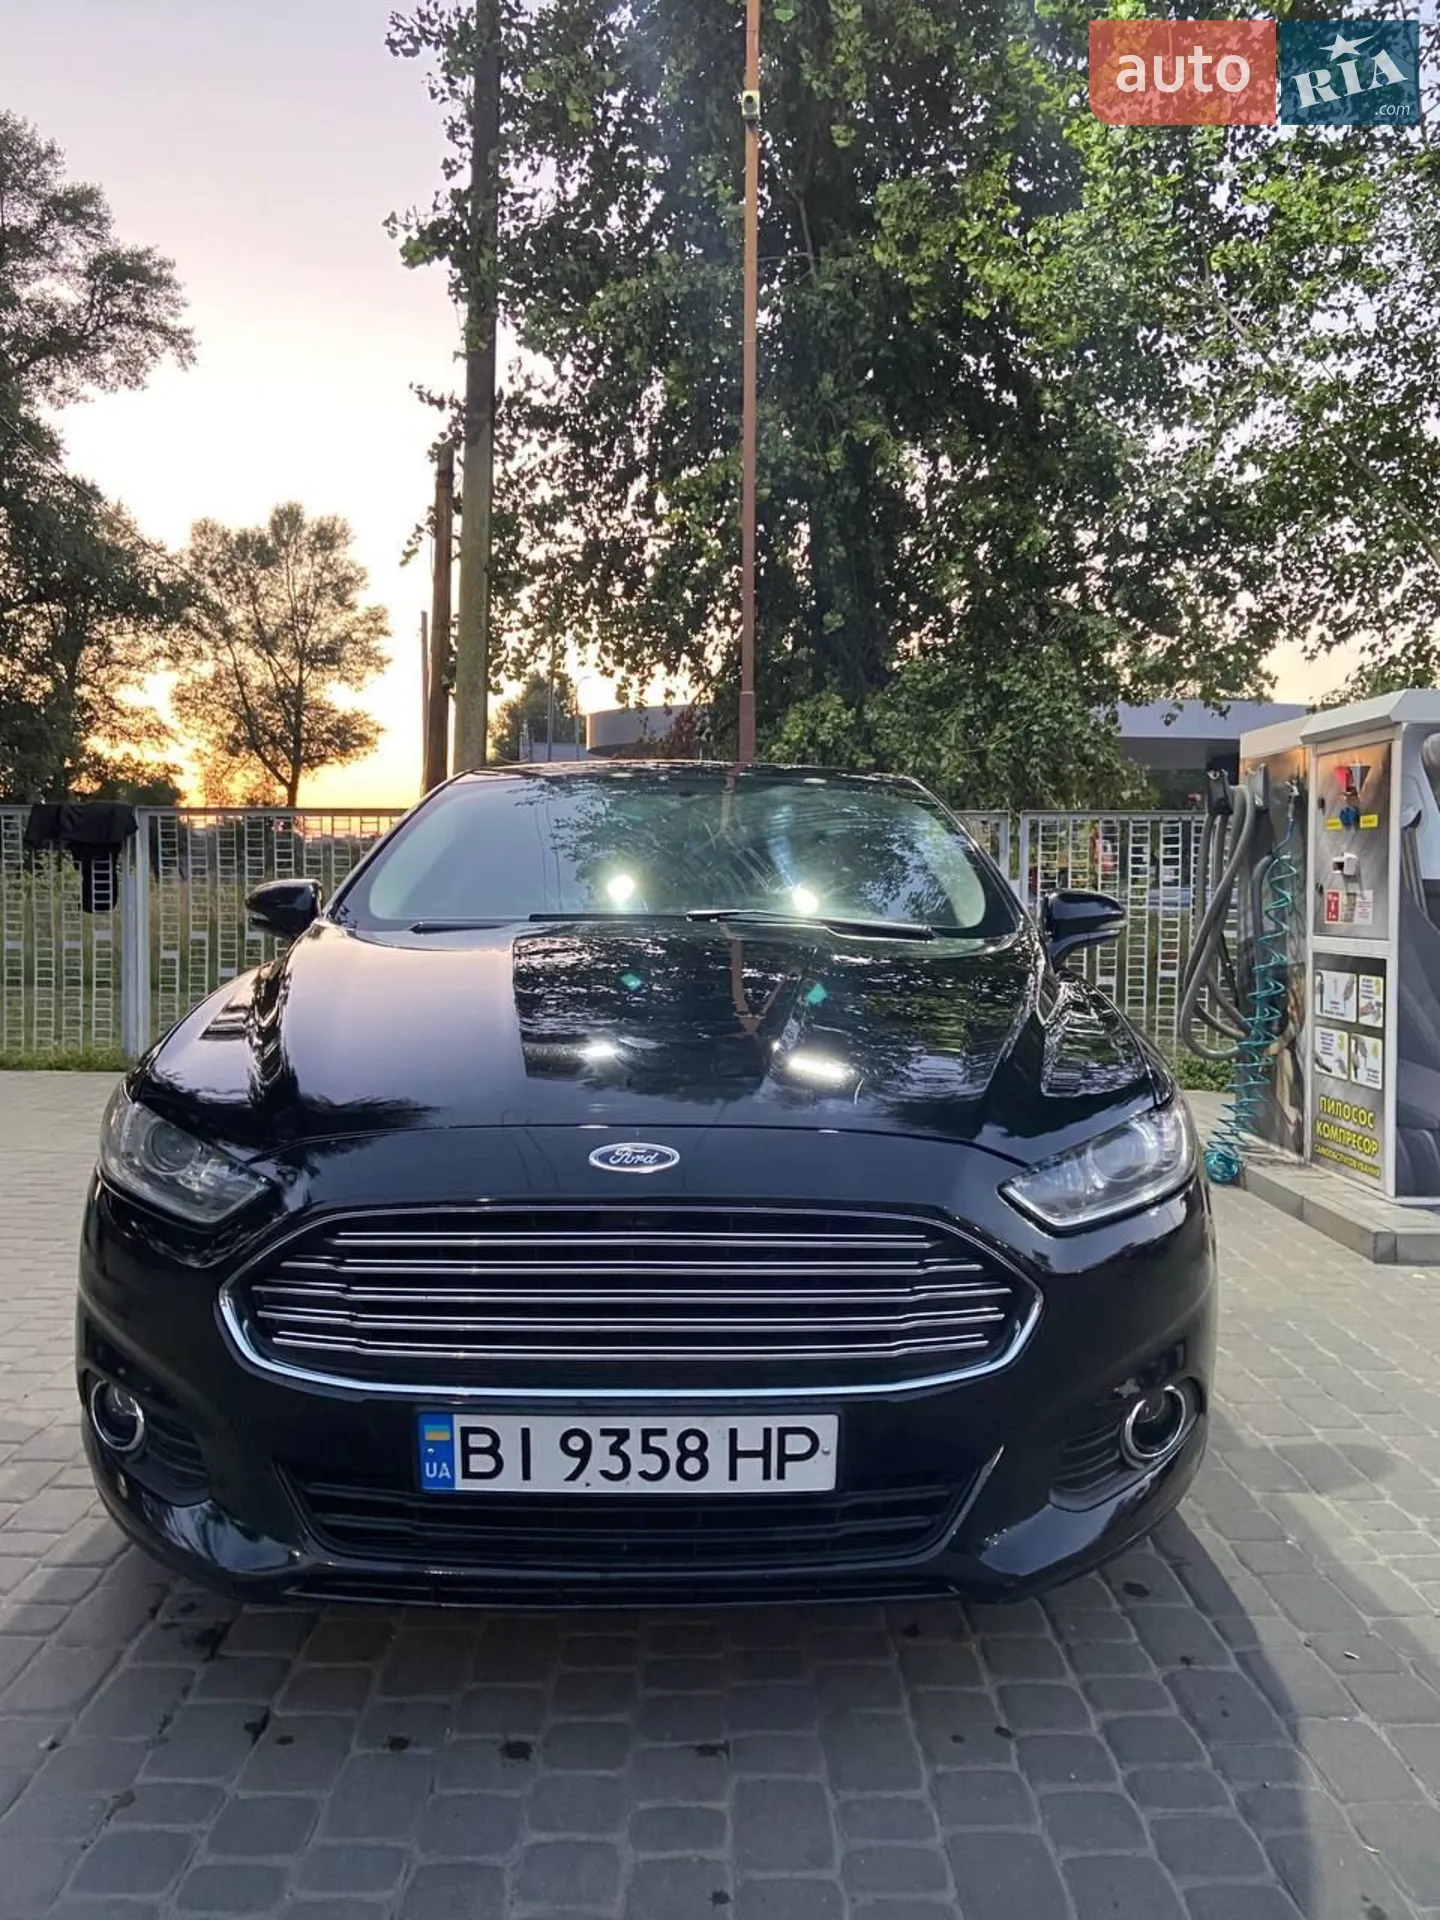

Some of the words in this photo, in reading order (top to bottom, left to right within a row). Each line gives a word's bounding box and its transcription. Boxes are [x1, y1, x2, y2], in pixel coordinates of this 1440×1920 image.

[1319, 1095, 1375, 1129] ПИЛОСОС
[1315, 1118, 1379, 1155] КОМПРЕСОР
[608, 1146, 660, 1165] Ford
[425, 1461, 452, 1479] UA
[559, 1427, 710, 1482] 9358
[728, 1426, 821, 1481] HP
